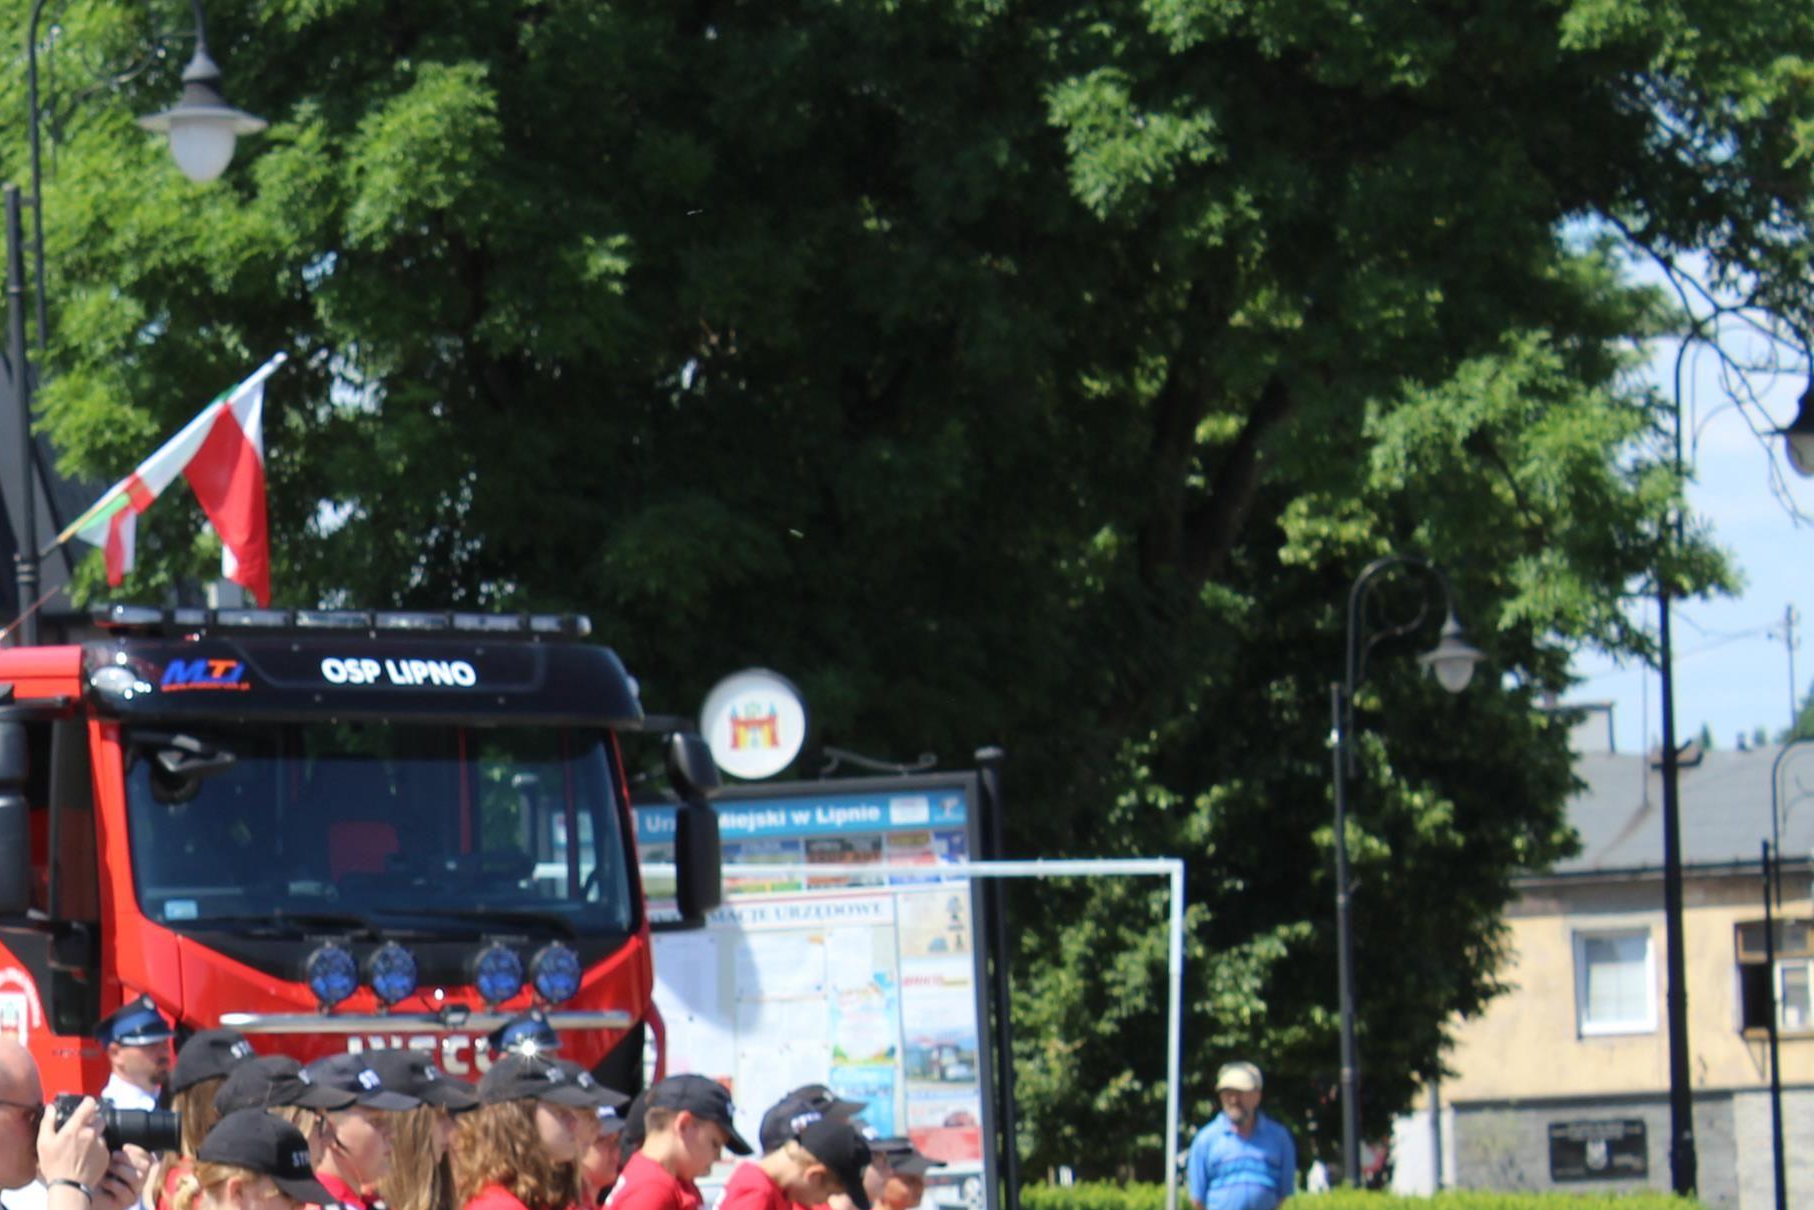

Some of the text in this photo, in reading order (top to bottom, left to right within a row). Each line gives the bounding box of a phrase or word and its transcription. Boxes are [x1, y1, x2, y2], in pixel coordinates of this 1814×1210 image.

[321, 657, 477, 687] OSP LIPNO
[791, 810, 811, 826] w
[816, 803, 881, 827] Lipnie
